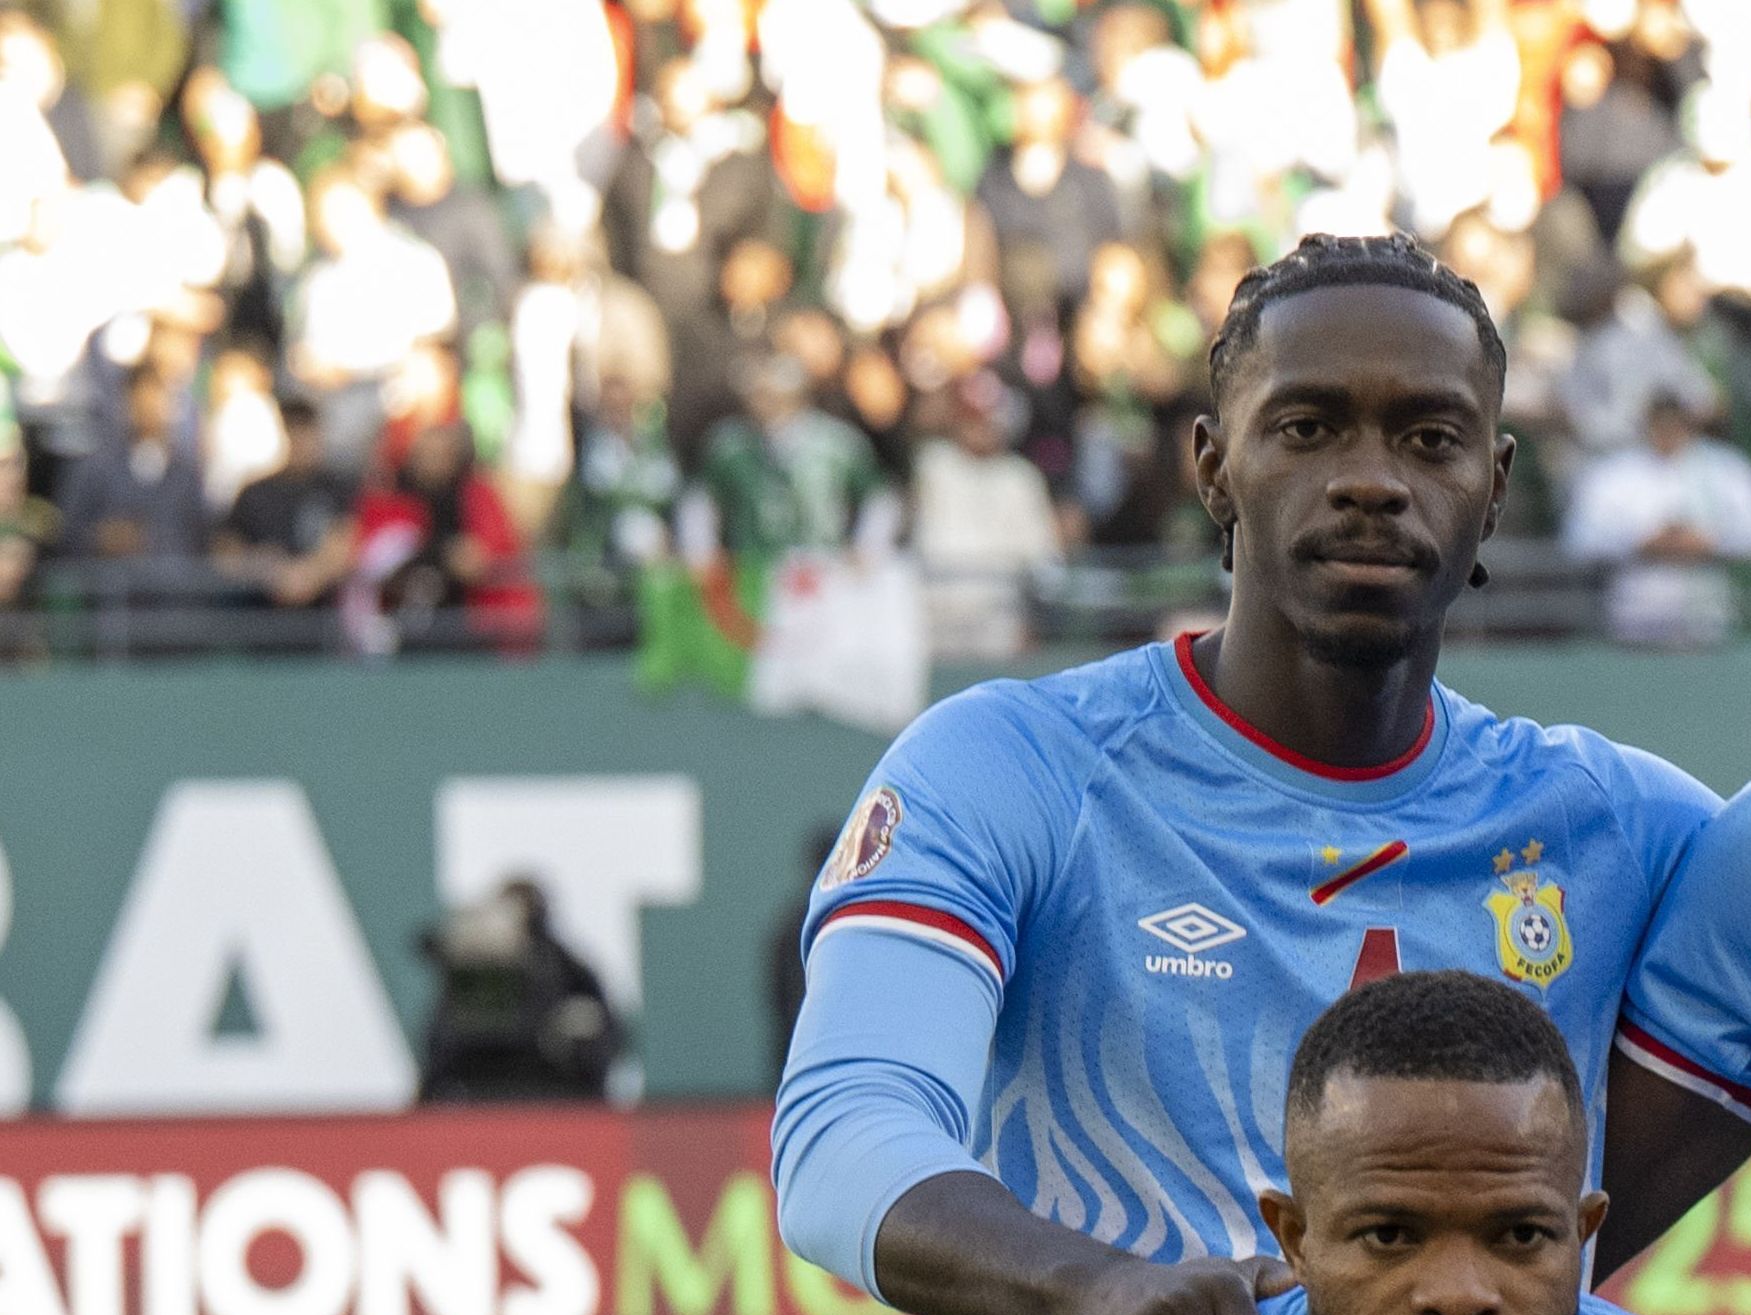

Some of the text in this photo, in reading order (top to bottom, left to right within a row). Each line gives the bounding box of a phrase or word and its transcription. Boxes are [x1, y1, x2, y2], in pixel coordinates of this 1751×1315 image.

[0, 776, 703, 1120] AT
[1145, 955, 1232, 979] umbro
[1517, 952, 1565, 976] FECOFA
